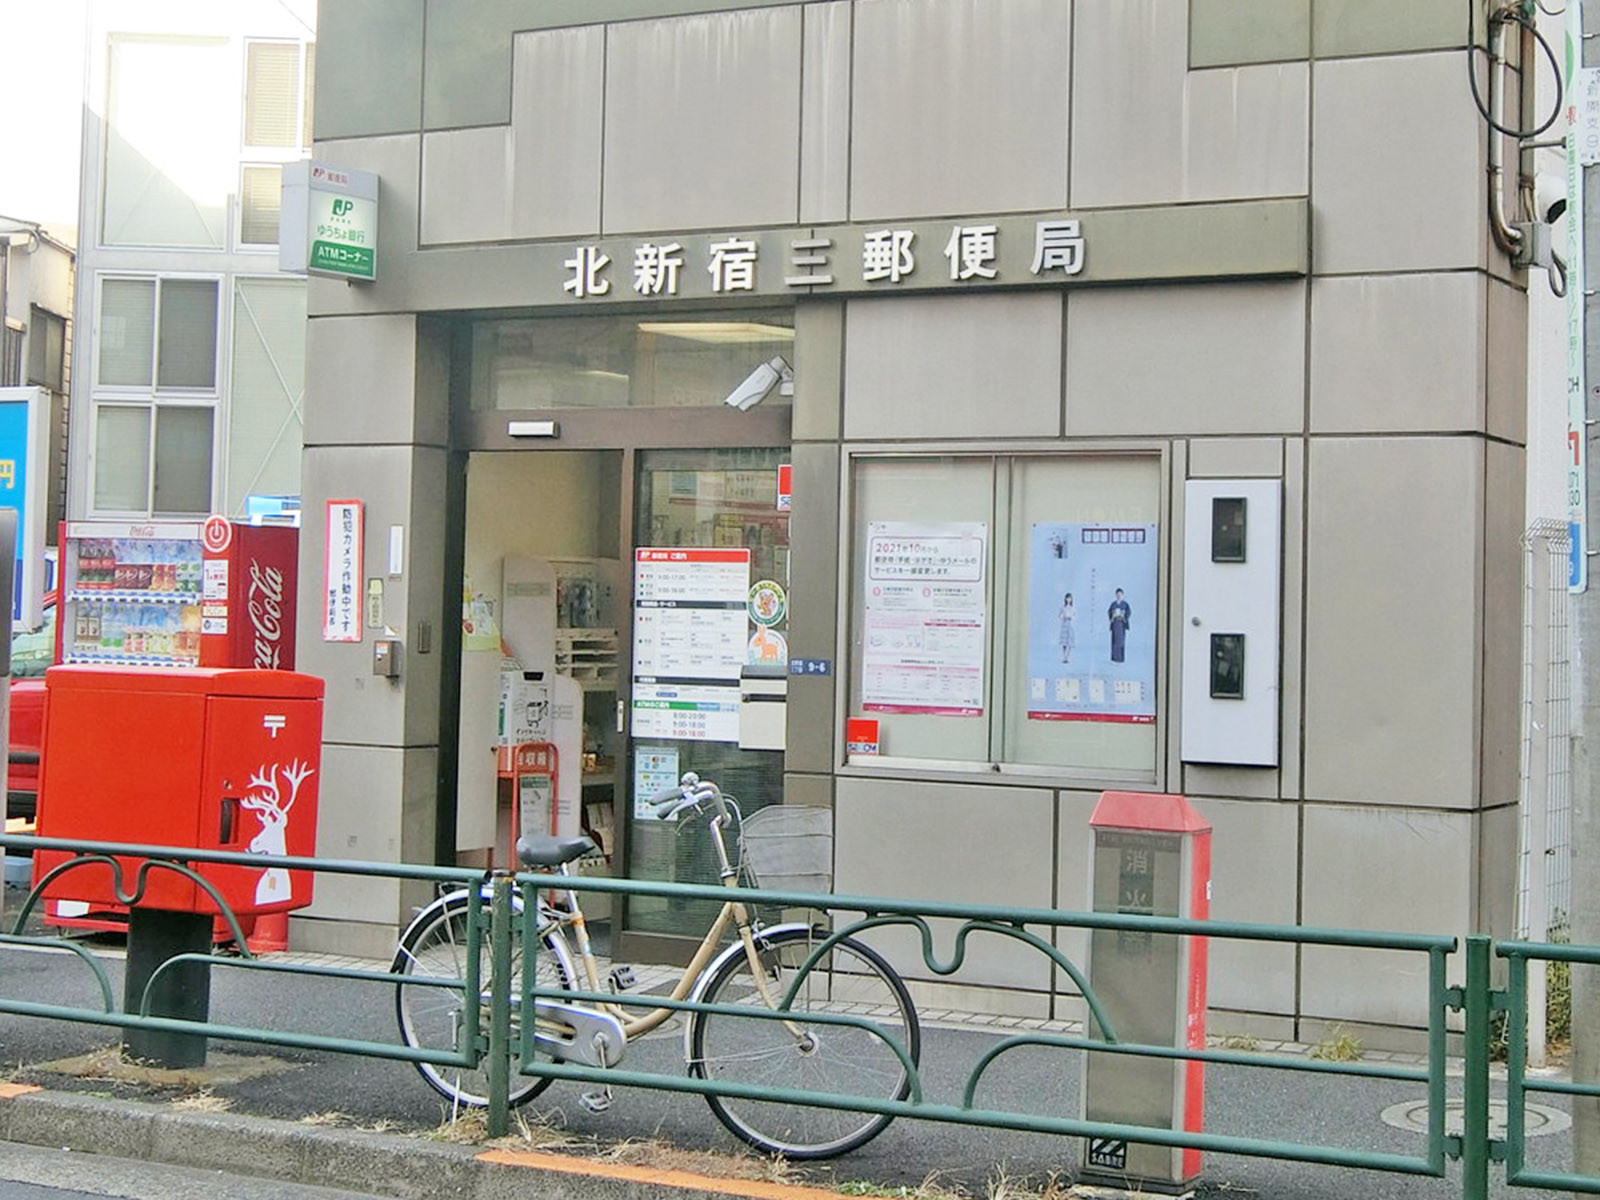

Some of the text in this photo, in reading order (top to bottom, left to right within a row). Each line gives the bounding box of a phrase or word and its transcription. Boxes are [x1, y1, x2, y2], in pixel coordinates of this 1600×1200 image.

[317, 224, 366, 244] ゆうちょ銀行
[318, 245, 369, 263] ATMコーナー
[562, 218, 1088, 298] 北新宿三郵便局
[341, 507, 353, 632] 防犯カメラ作動中です
